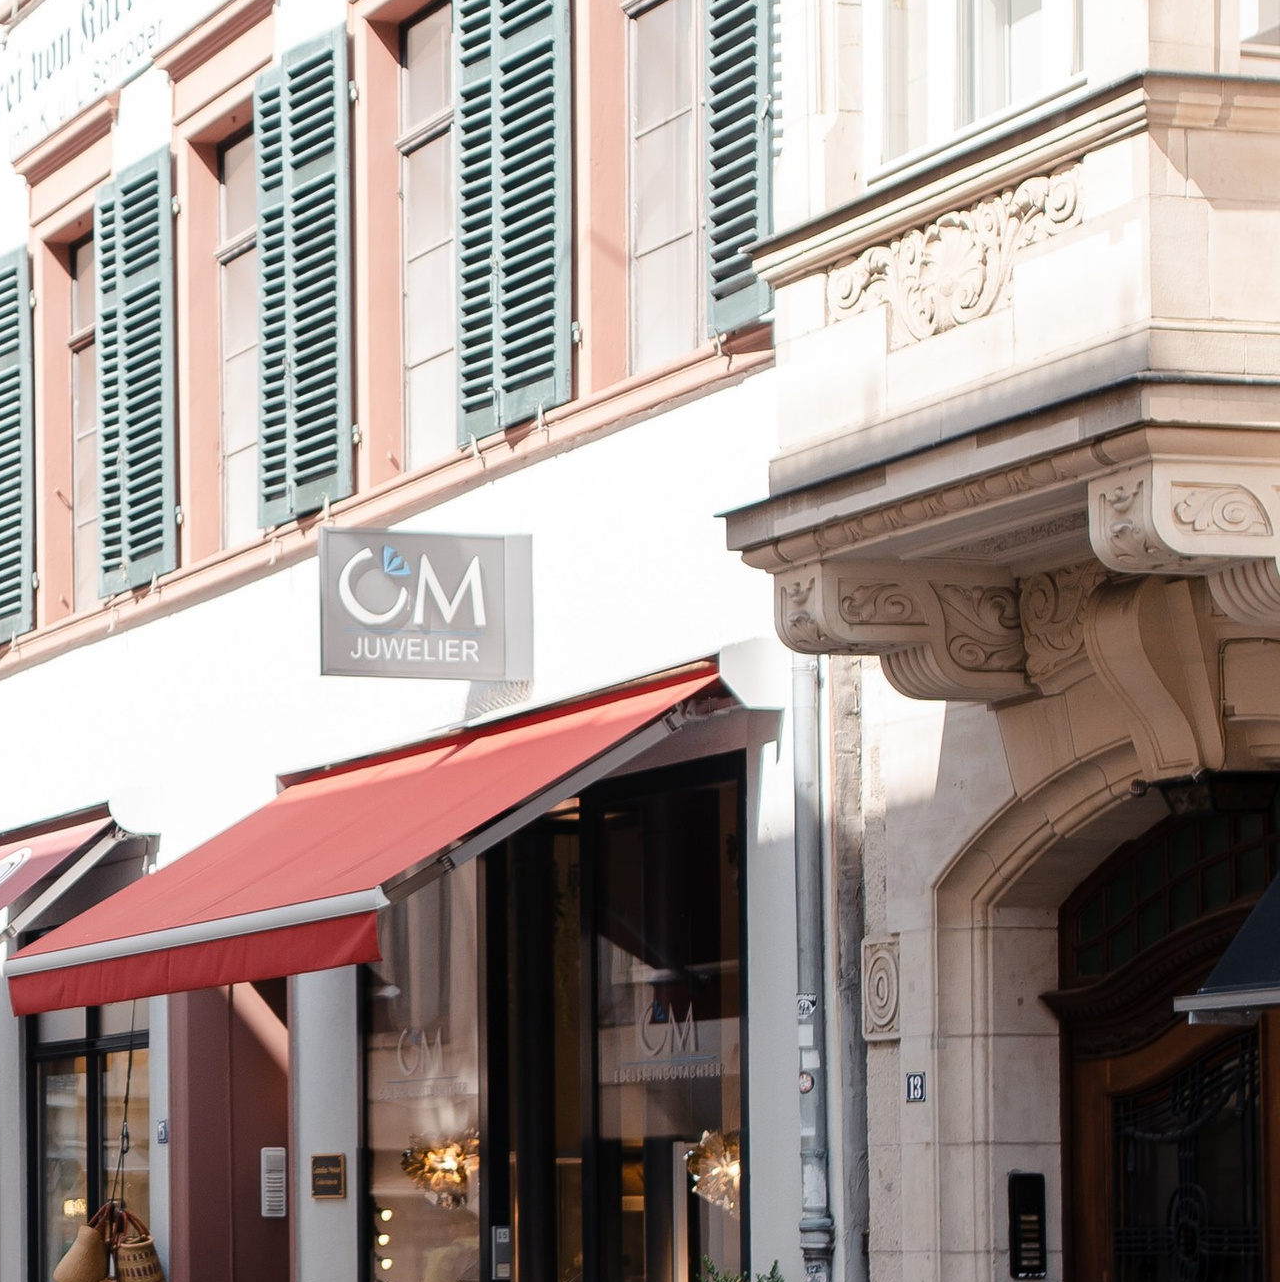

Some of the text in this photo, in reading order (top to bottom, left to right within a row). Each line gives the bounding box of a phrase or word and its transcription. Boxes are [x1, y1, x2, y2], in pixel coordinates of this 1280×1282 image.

[31, 27, 72, 91] von
[337, 545, 487, 628] CM
[349, 635, 480, 663] JUWELIER
[909, 1075, 923, 1099] 13
[498, 1230, 508, 1239] 15
